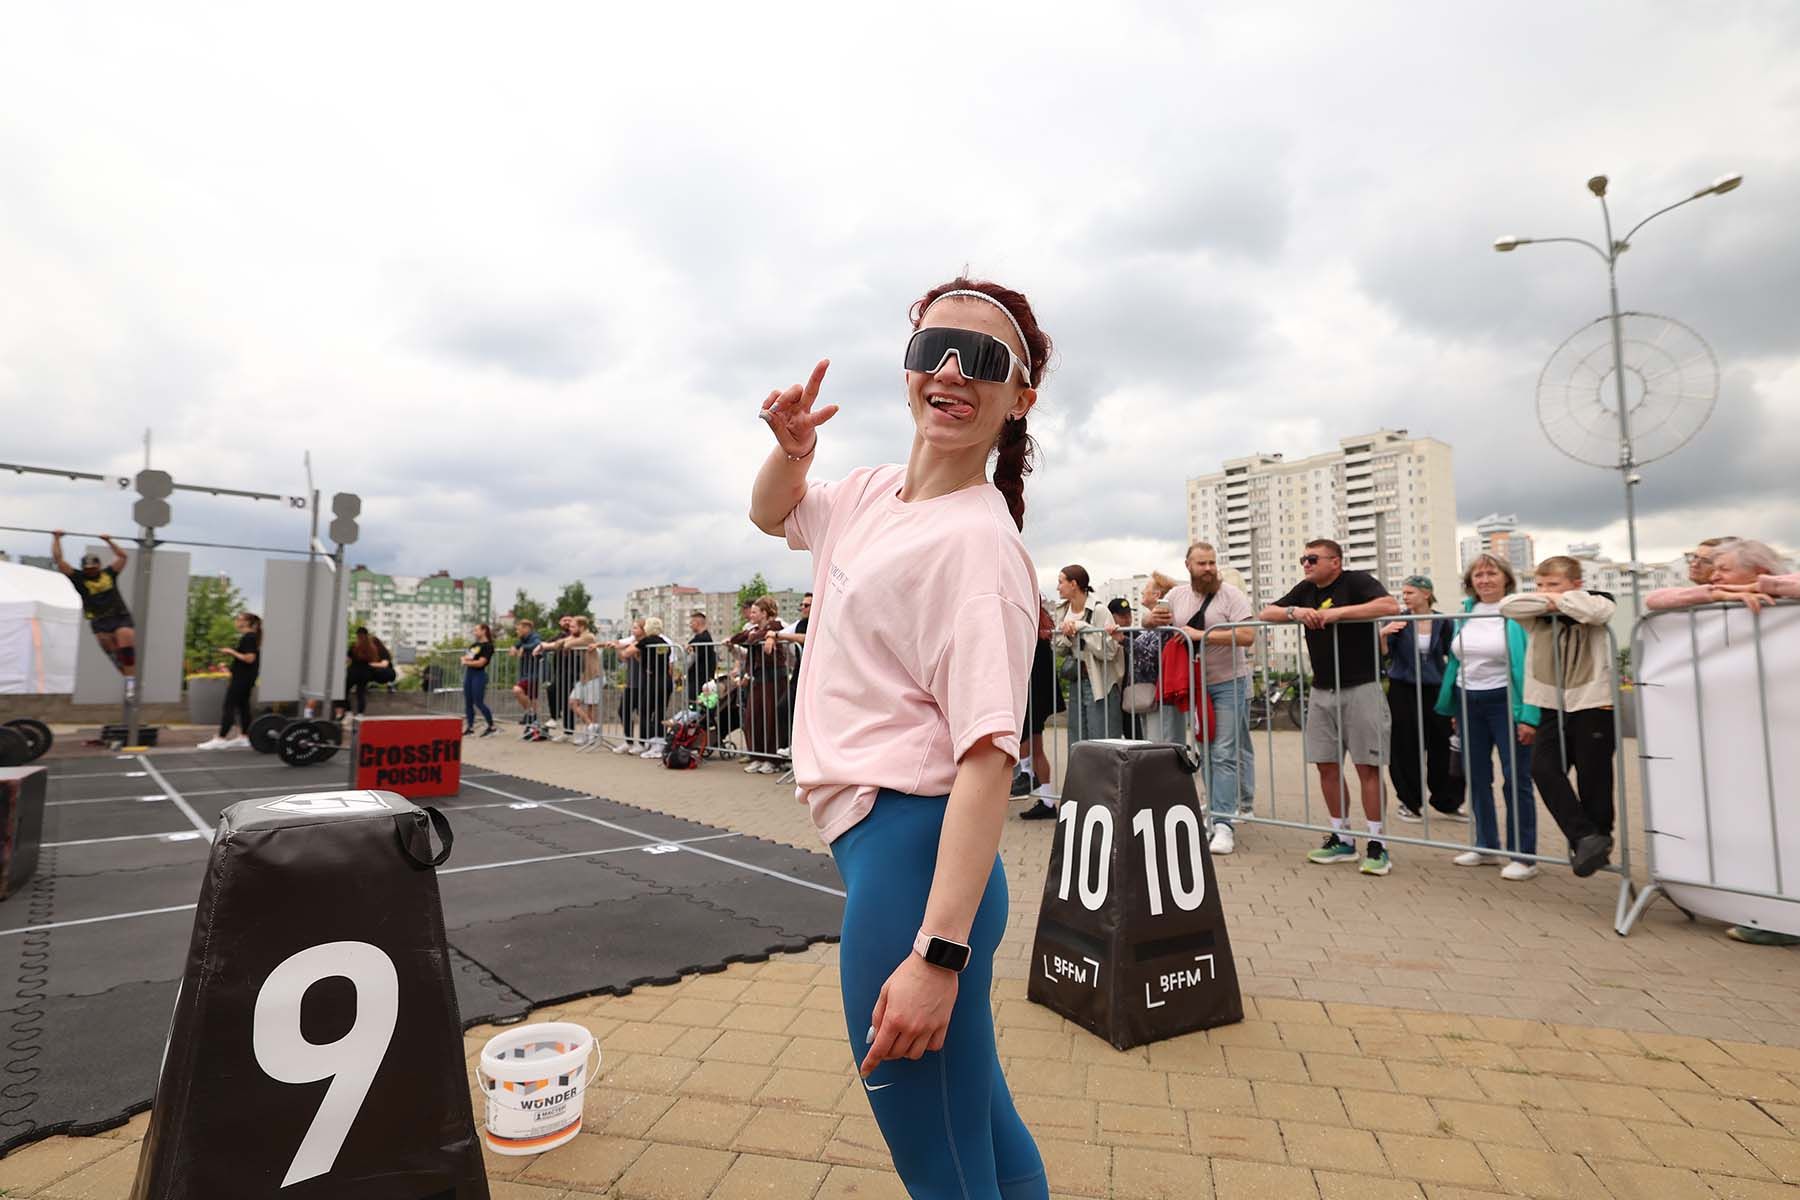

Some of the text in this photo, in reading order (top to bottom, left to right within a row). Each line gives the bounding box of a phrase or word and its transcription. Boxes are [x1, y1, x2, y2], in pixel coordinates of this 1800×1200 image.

[376, 765, 443, 787] POISON
[1058, 800, 1114, 911] 10
[1132, 804, 1205, 916] 10
[1054, 956, 1087, 984] BFFM
[1160, 967, 1201, 993] BFFM
[253, 940, 399, 1189] 9
[520, 1087, 577, 1110] WONDER
